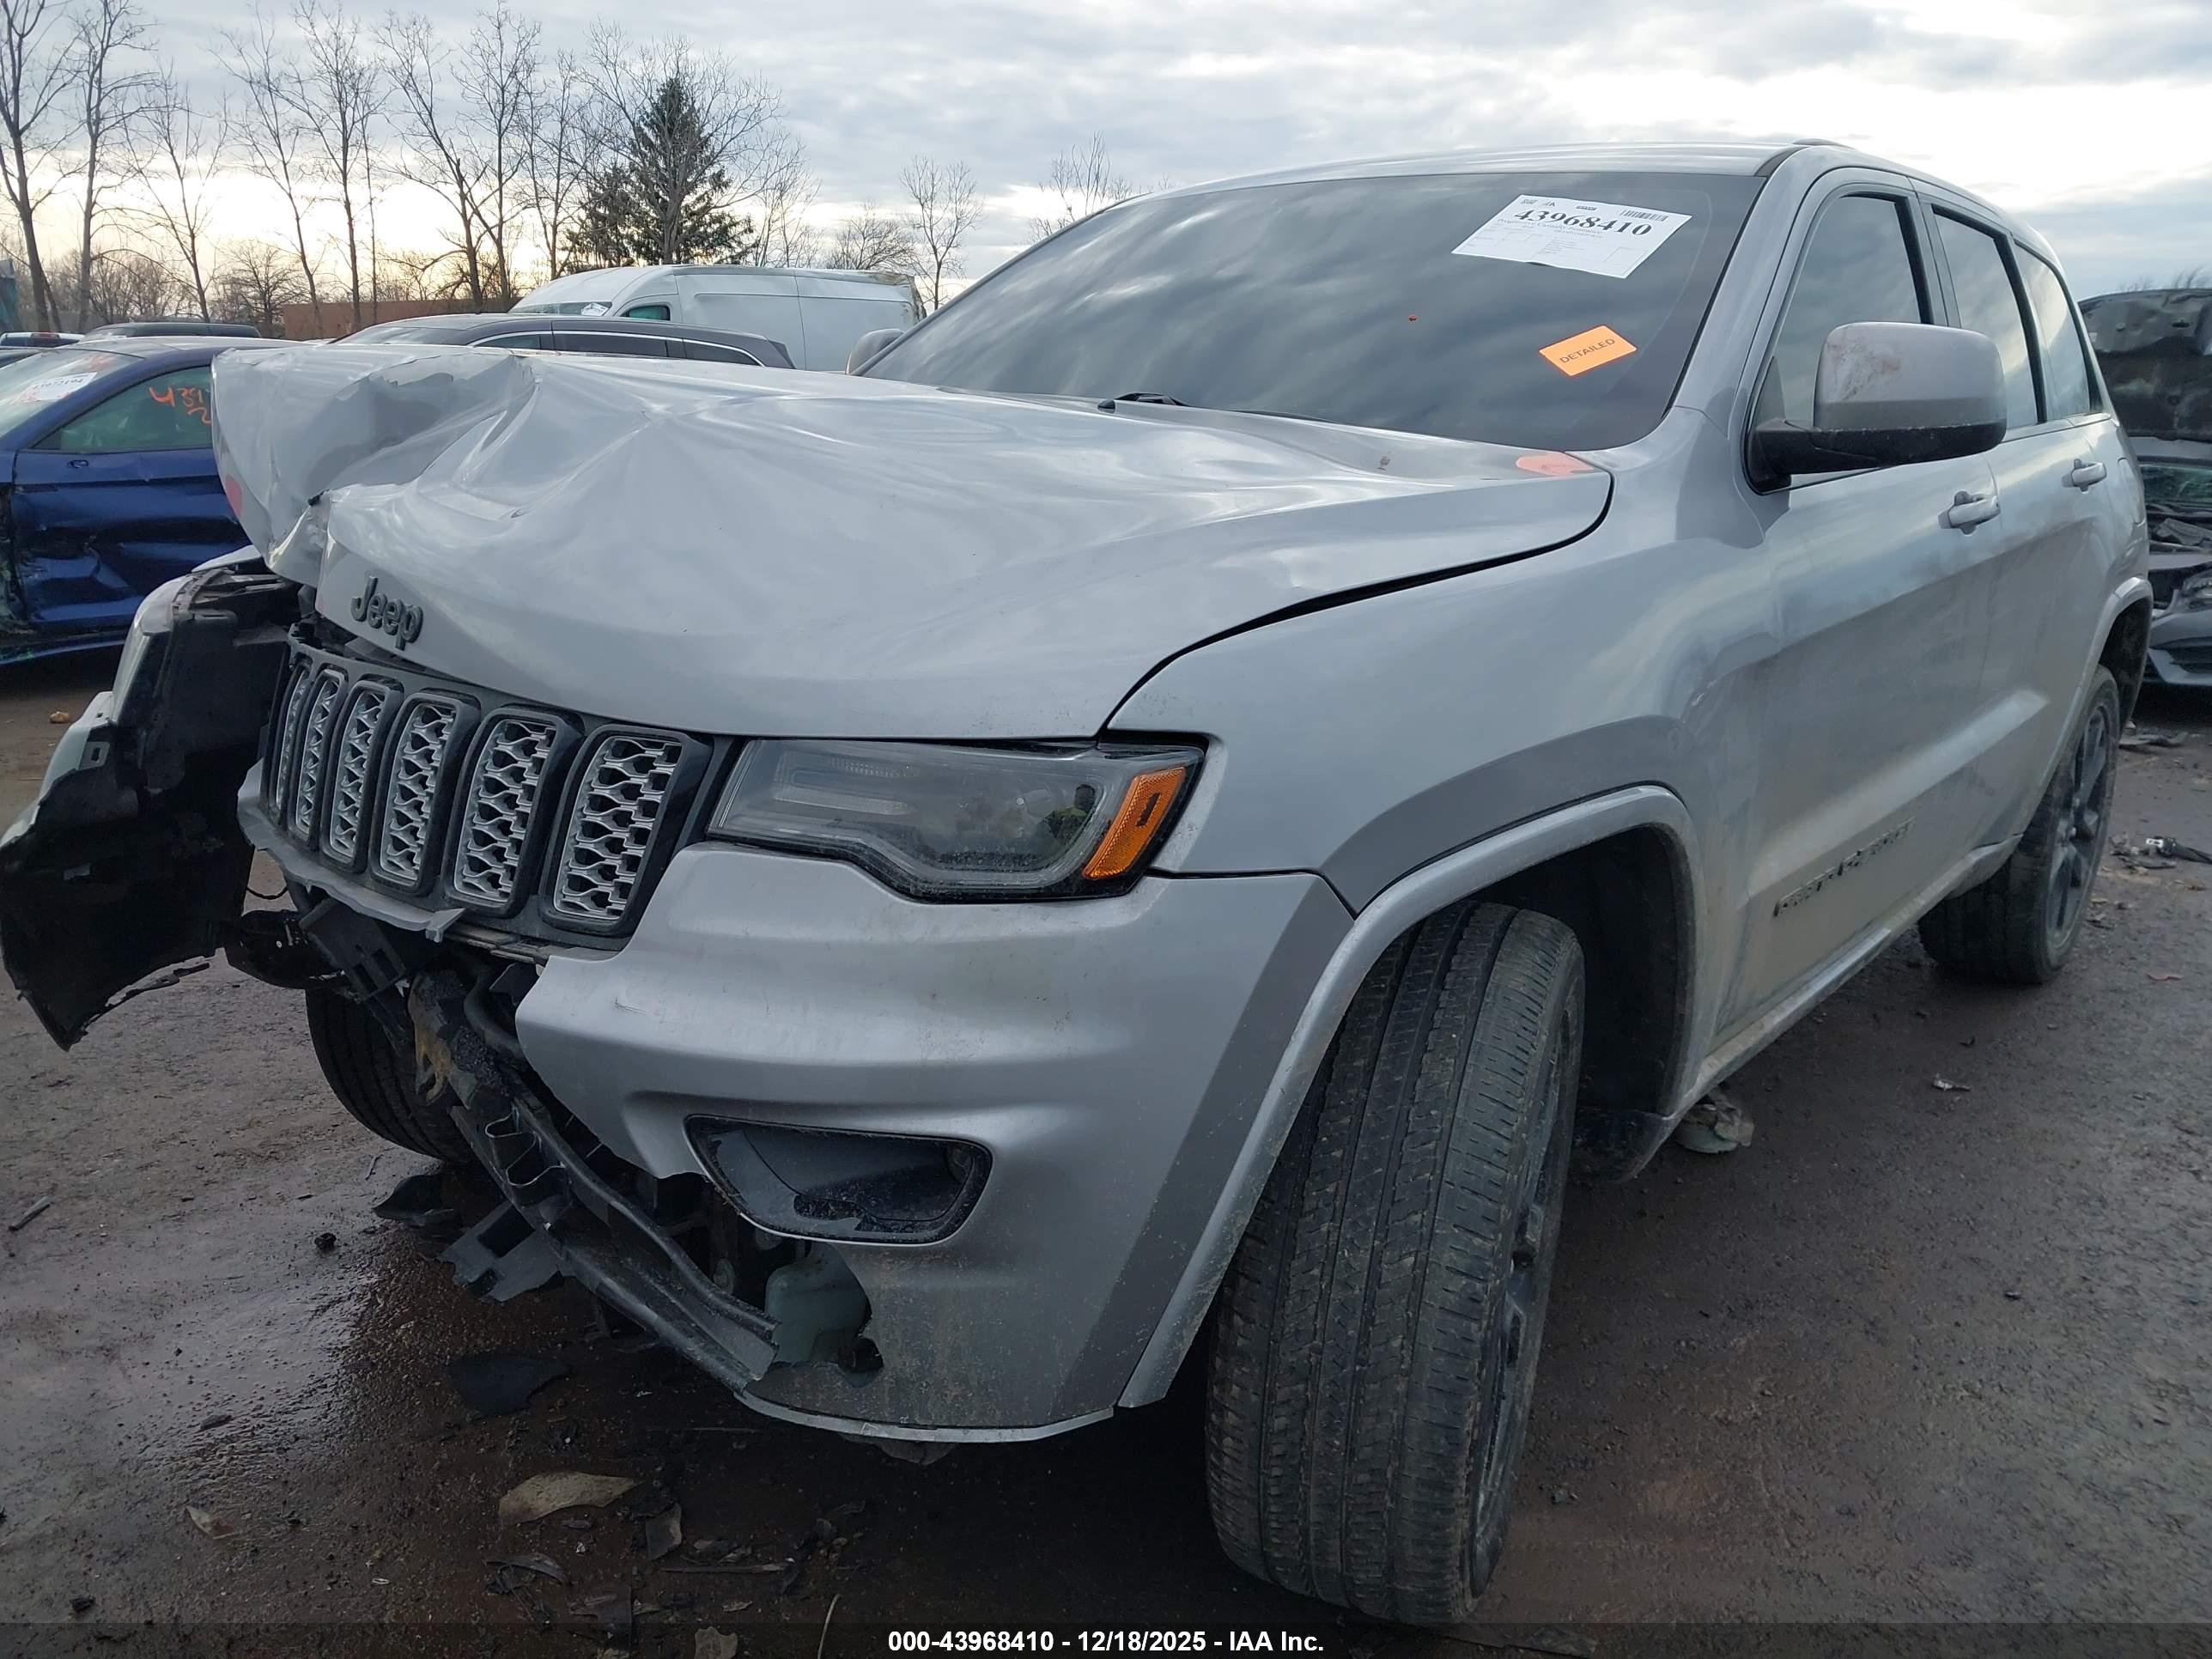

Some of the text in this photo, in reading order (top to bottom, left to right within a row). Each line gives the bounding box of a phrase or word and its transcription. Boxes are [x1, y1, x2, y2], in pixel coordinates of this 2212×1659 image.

[1514, 210, 1652, 236] 43968410
[1559, 338, 1615, 364] DETAILED
[350, 574, 423, 652] Jeep
